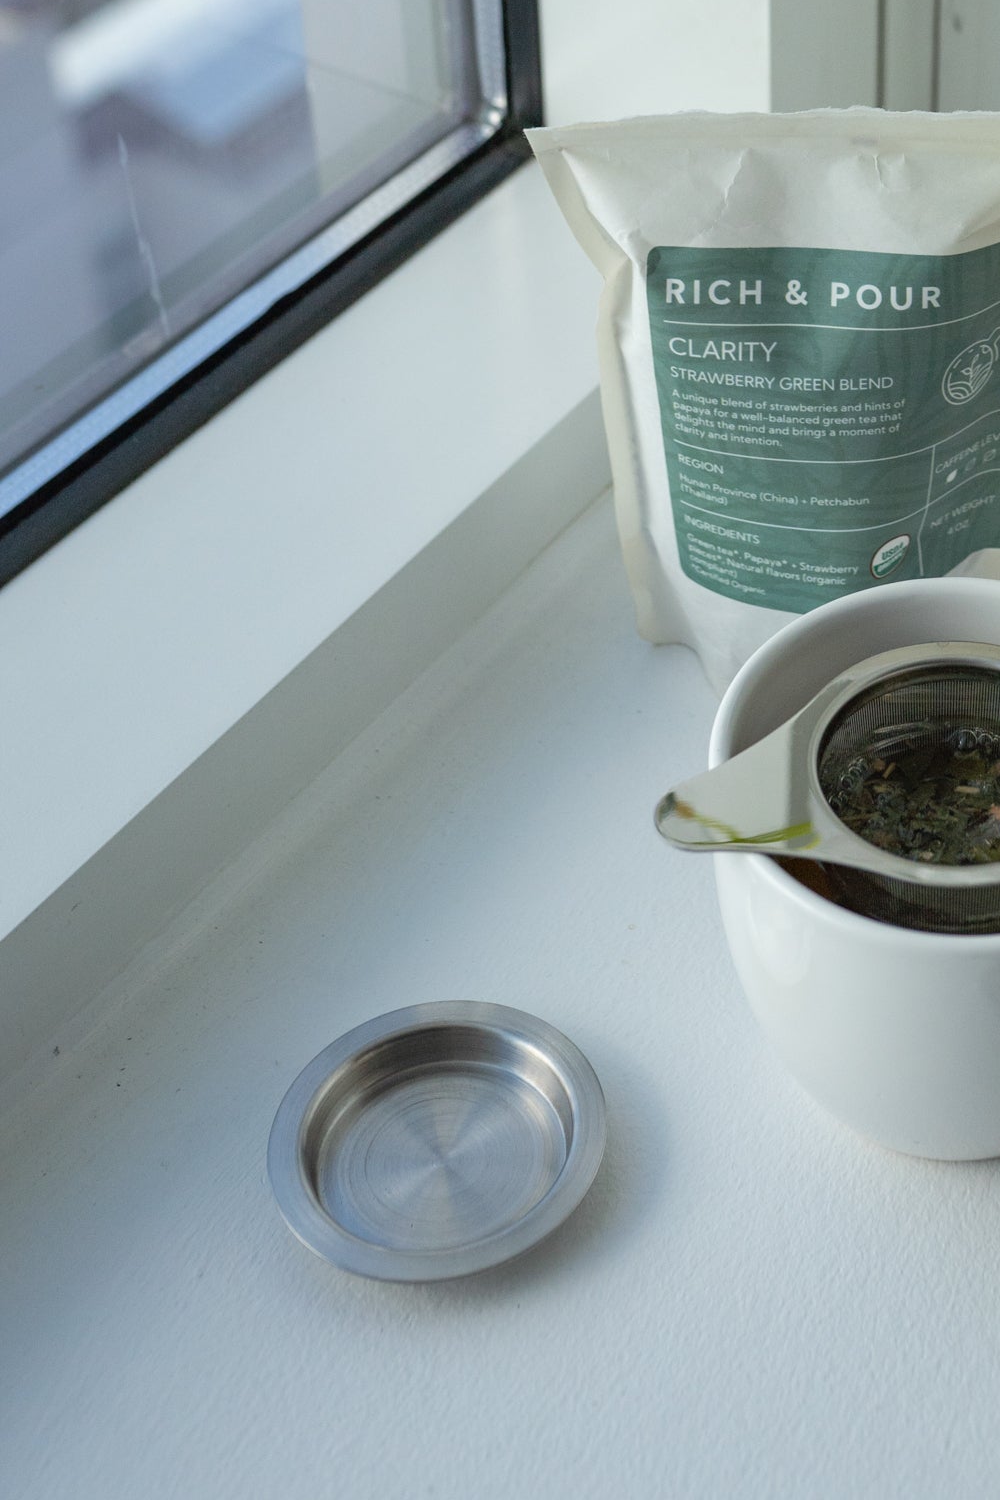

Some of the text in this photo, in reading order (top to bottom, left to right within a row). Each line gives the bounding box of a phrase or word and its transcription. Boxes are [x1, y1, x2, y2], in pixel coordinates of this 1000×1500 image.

[665, 278, 941, 311] RICH & POUR
[668, 337, 777, 362] CLARITY
[670, 366, 894, 391] STRAWBERRY GREEN BLEND
[672, 389, 906, 413] A unique blend of strawberries and hints of
[672, 402, 902, 427] papaya for a well-balanced green tea that
[674, 411, 901, 439] delights the mind and brings a moment of
[675, 422, 783, 447] clarity and intention.
[678, 453, 724, 474] REGION
[935, 441, 980, 474] CAFFEINE
[679, 473, 711, 489] Hunan
[712, 484, 757, 500] Province
[759, 492, 798, 505] (China)
[810, 496, 869, 507] Petchabun
[680, 483, 728, 507] (Thailand)
[951, 495, 997, 517] WEIGHT
[684, 514, 761, 544] INGREDIENTS
[686, 532, 716, 551] Green
[799, 562, 859, 575] Strawberry
[726, 558, 764, 574] Natural
[766, 567, 801, 581] flavors
[802, 574, 847, 586] (organic
